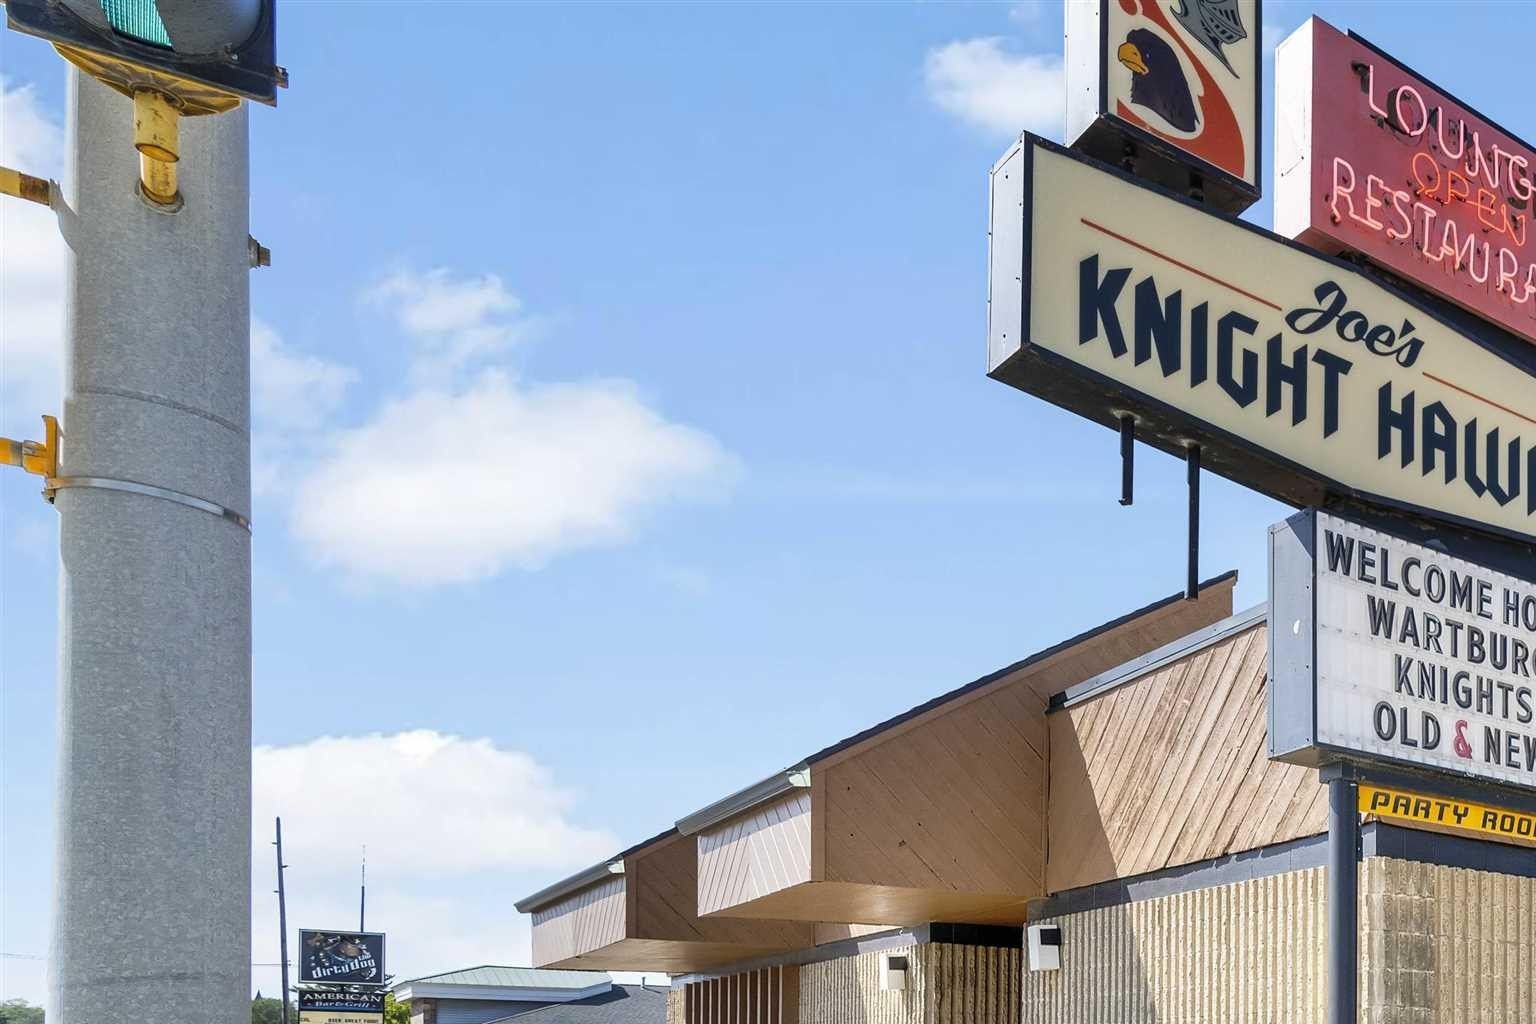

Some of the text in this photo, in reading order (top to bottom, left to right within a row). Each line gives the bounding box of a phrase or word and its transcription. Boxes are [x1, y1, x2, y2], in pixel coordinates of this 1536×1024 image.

[1412, 152, 1526, 246] OPEN
[1078, 254, 1353, 439] KNIGHT
[1285, 280, 1425, 368] Joe's
[1325, 529, 1493, 620] WELCOME
[1394, 653, 1533, 724] KNIGHTS
[1373, 700, 1441, 750] OLD
[1453, 719, 1473, 760] &
[1370, 790, 1470, 830] PARTY
[304, 993, 381, 1002] AMERICAN
